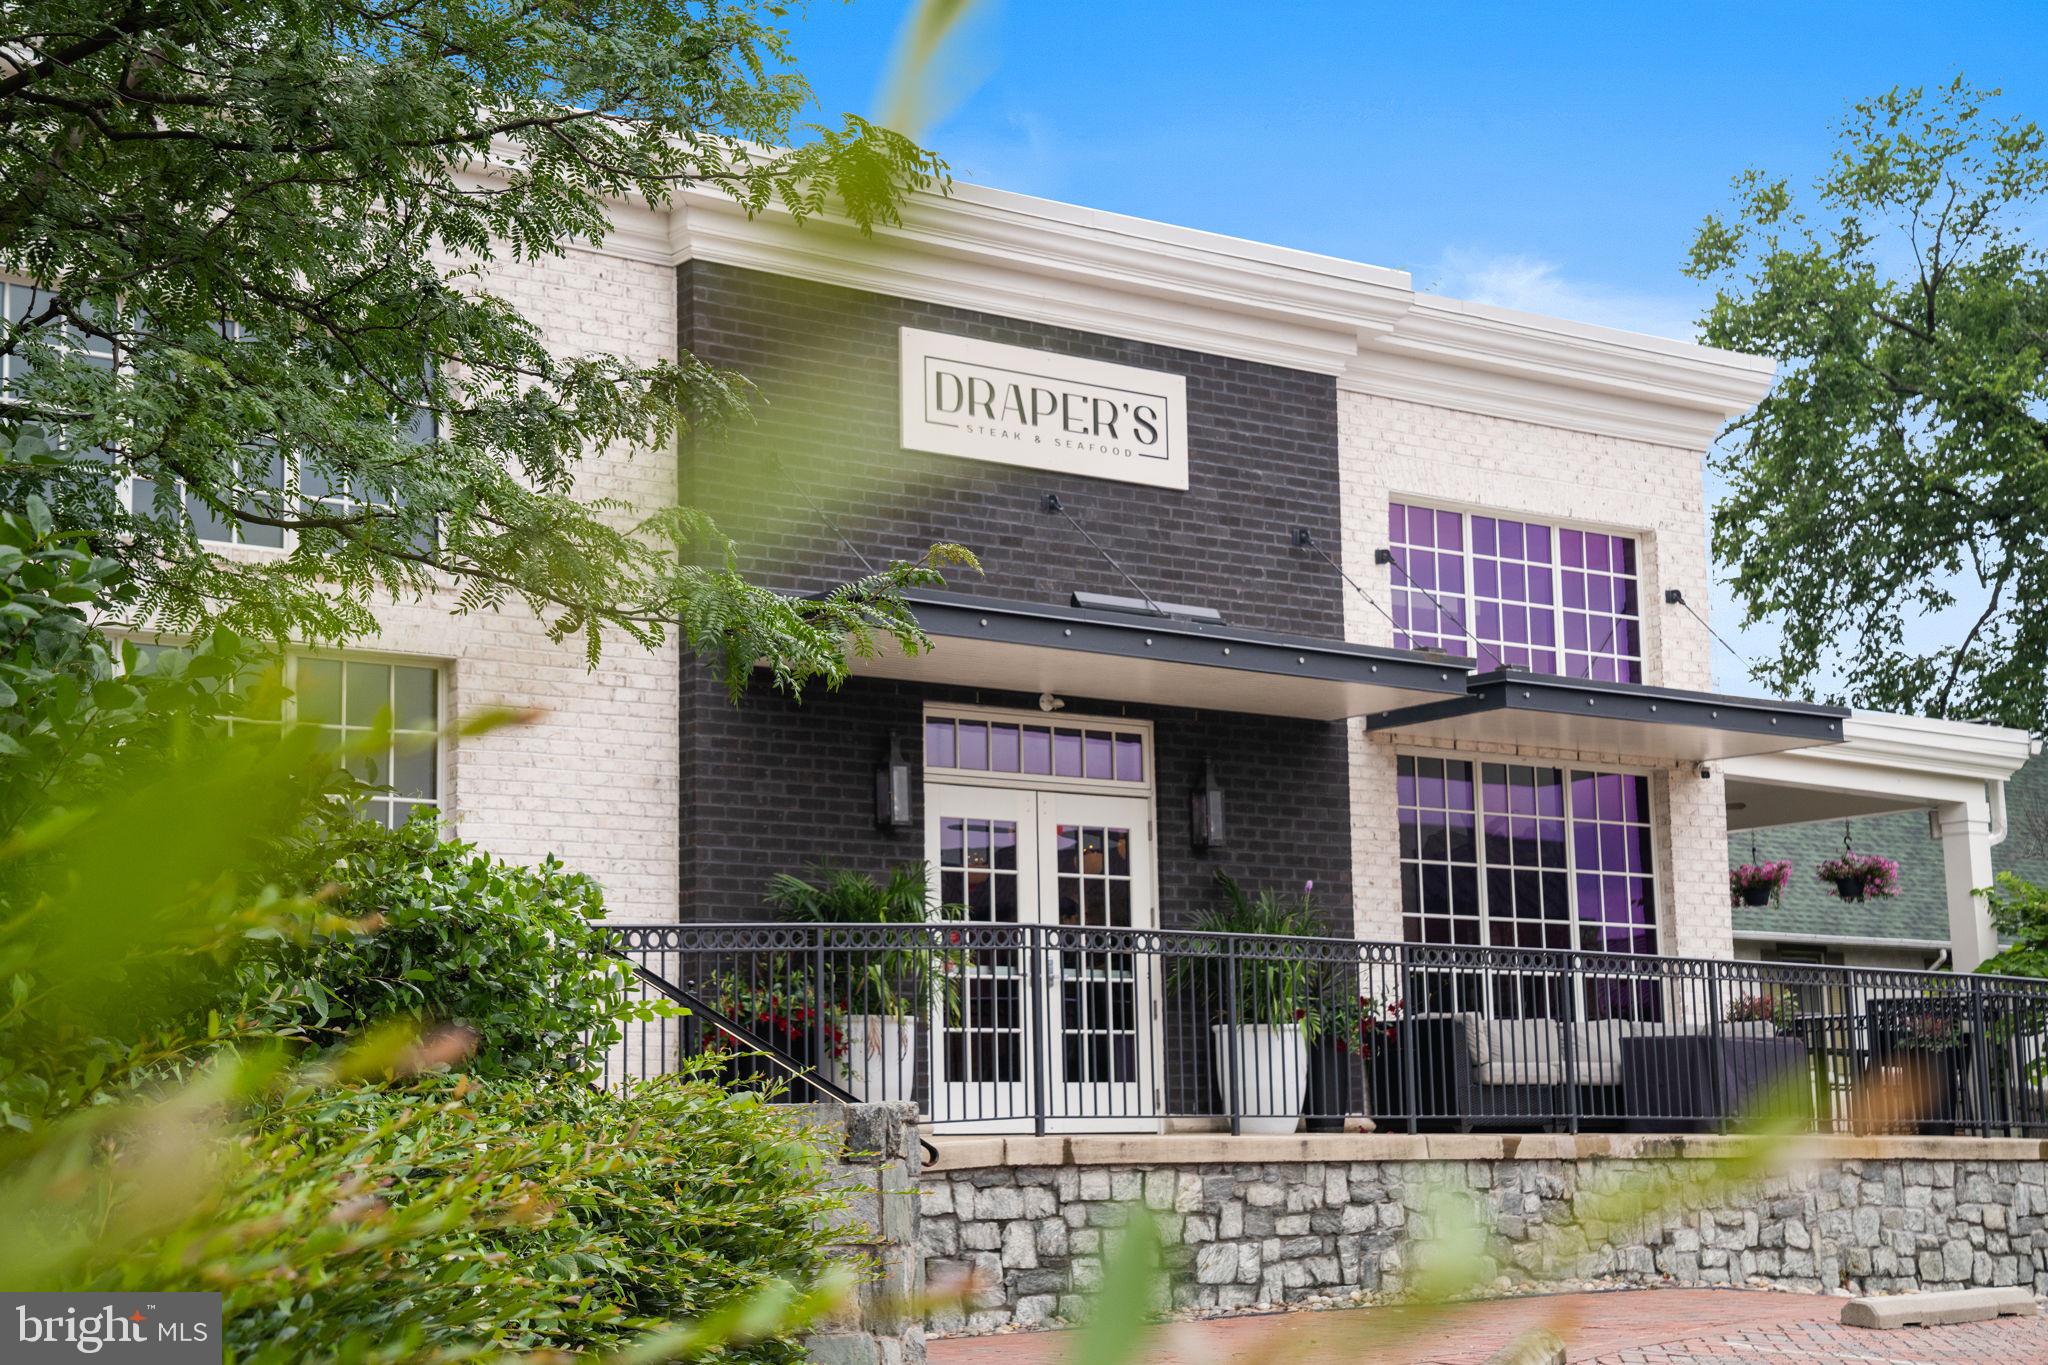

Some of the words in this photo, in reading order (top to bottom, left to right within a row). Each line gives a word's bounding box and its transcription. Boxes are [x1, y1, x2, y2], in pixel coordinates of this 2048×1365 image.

[935, 370, 1159, 446] DRAPER'S
[965, 424, 1022, 441] STEAK
[1033, 434, 1042, 445] &
[1054, 437, 1133, 458] SEAFOOD
